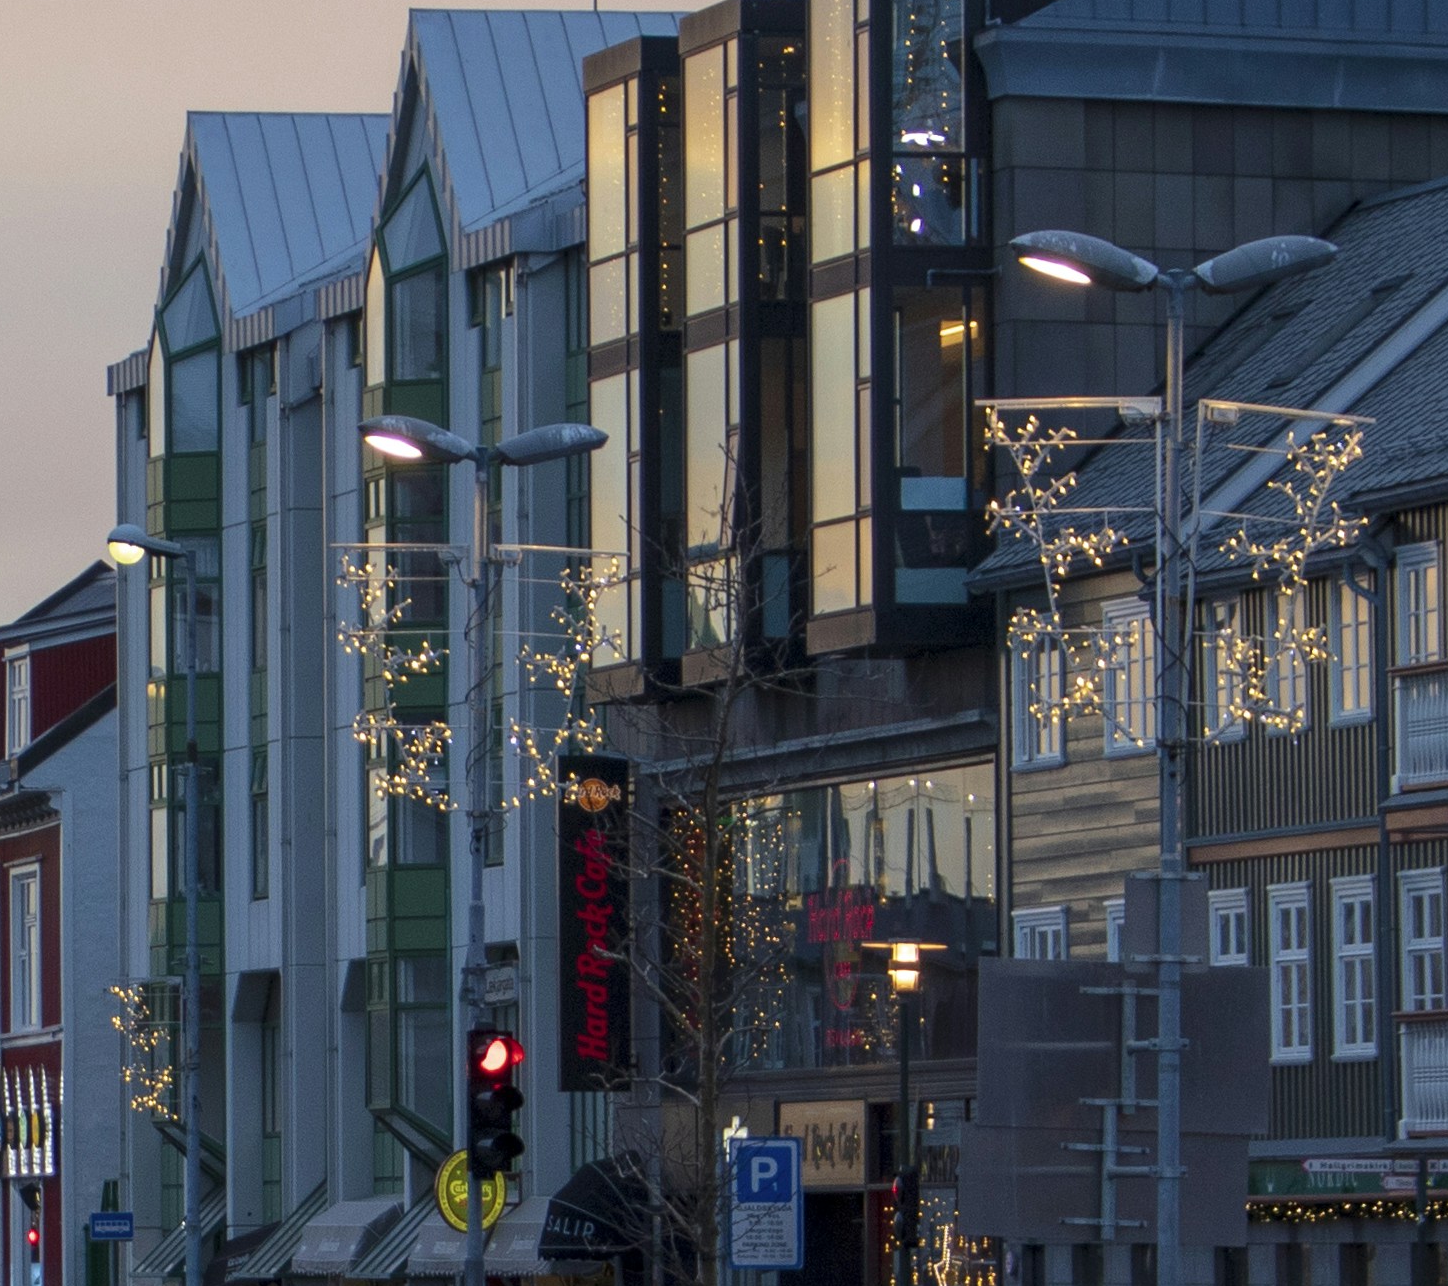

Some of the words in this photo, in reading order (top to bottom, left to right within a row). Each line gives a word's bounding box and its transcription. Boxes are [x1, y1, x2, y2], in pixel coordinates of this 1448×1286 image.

[574, 828, 614, 900] Cafe
[575, 903, 615, 980] Rock
[576, 980, 609, 1061] Hard
[750, 1156, 779, 1194] P
